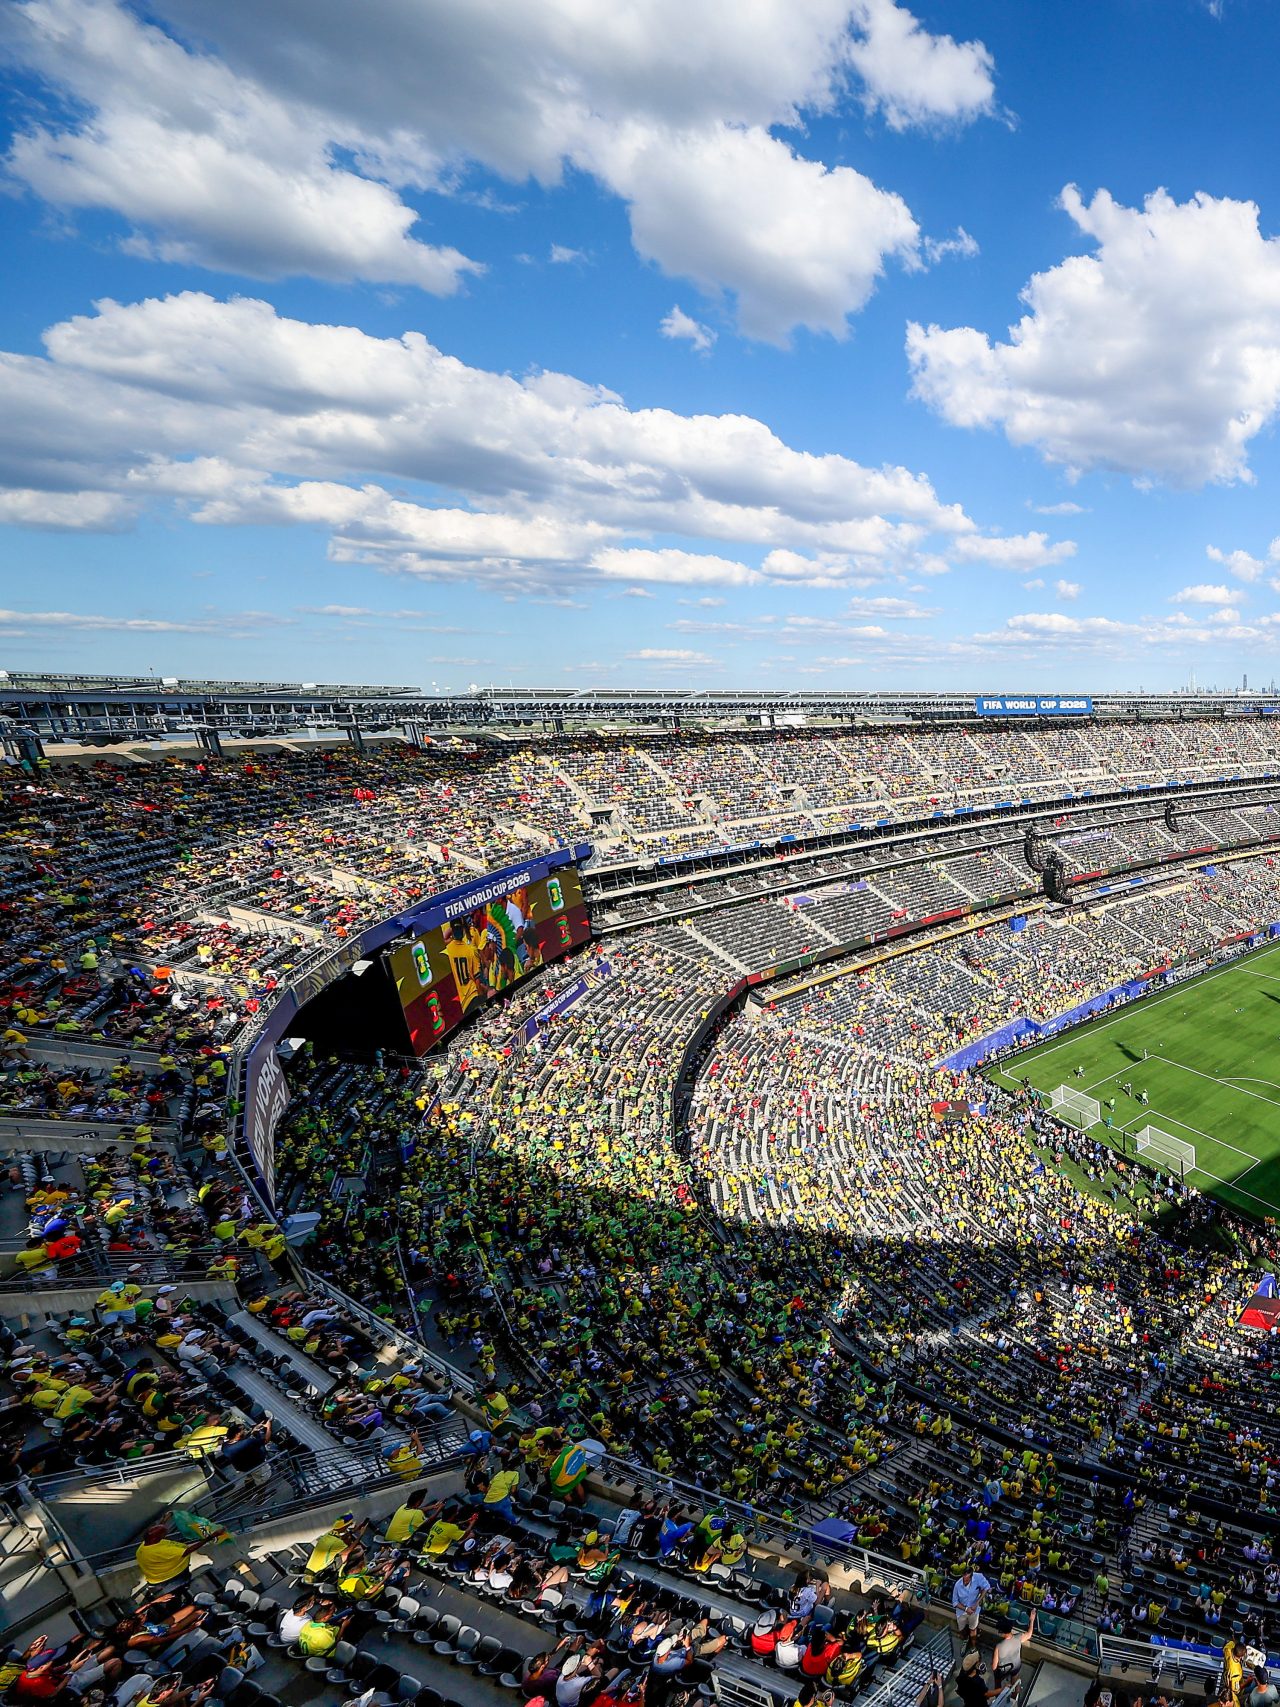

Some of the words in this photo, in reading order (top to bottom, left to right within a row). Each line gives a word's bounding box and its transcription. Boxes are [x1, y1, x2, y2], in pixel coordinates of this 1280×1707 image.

[983, 700, 1003, 710] FIFA
[1005, 700, 1037, 710] WORLD
[1040, 700, 1057, 710] CUP
[1059, 700, 1088, 709] 2026
[684, 850, 708, 860] YORK
[444, 902, 466, 919] FIFA
[464, 890, 493, 911] WORLD
[492, 882, 508, 898] CUP
[507, 872, 531, 890] 2026
[454, 956, 469, 986] 10
[256, 1049, 280, 1118] YORK
[254, 1105, 266, 1172] NEW
[616, 1518, 626, 1534] 7
[630, 1530, 643, 1548] 10
